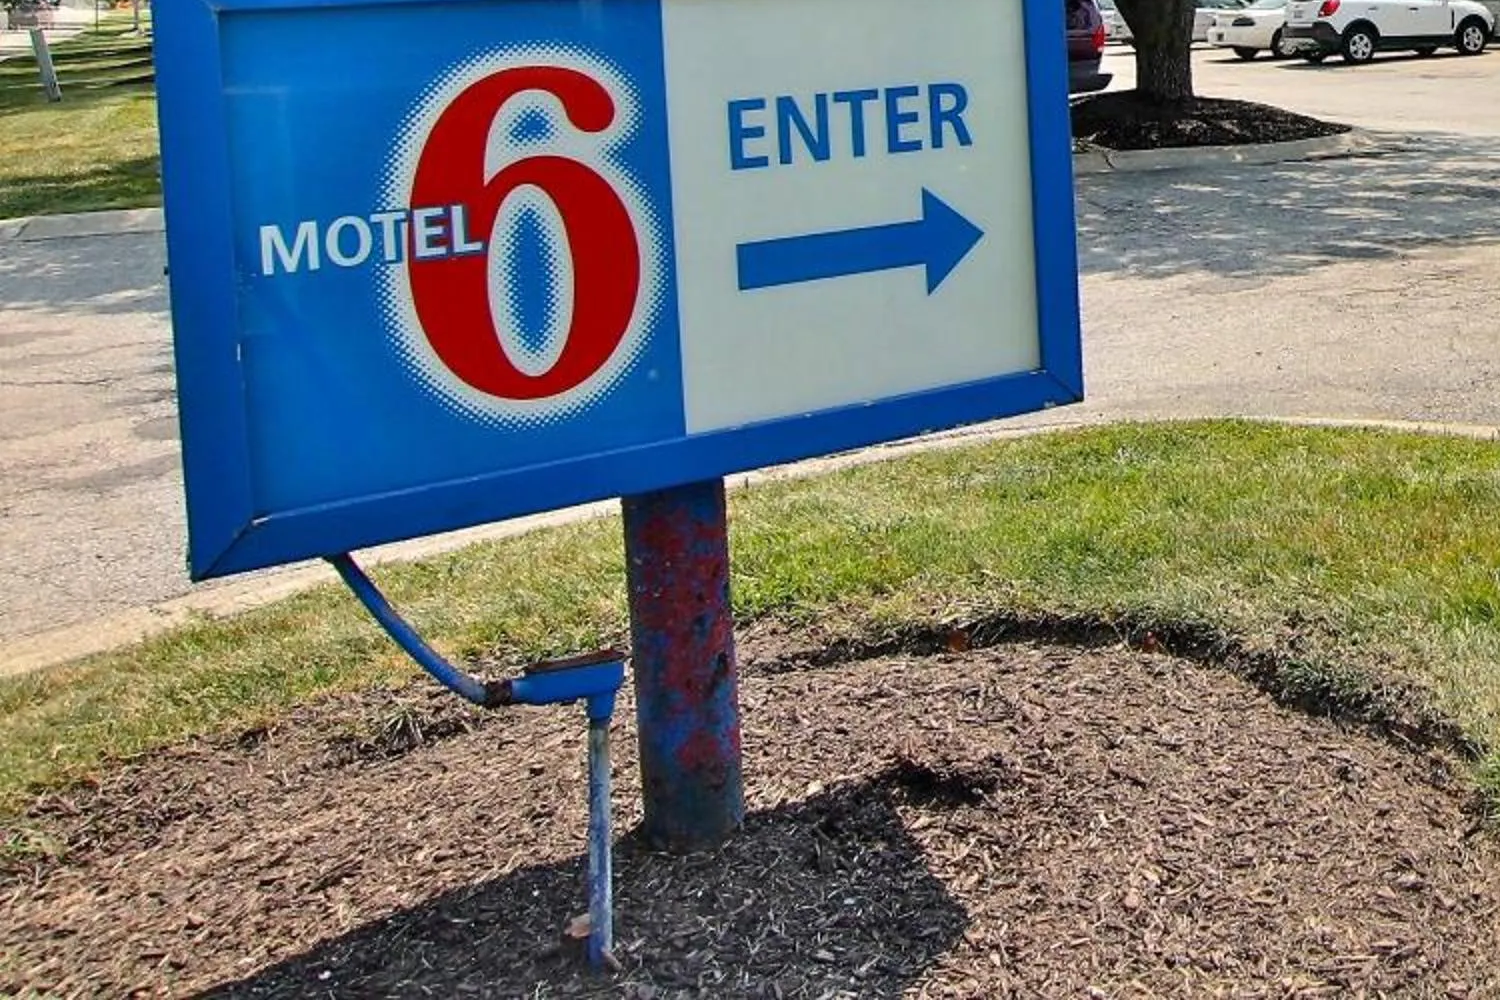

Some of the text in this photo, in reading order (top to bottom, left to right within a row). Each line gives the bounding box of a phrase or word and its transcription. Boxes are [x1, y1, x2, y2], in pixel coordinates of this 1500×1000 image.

[258, 64, 642, 401] MOTEL 6
[726, 82, 973, 171] ENTER
